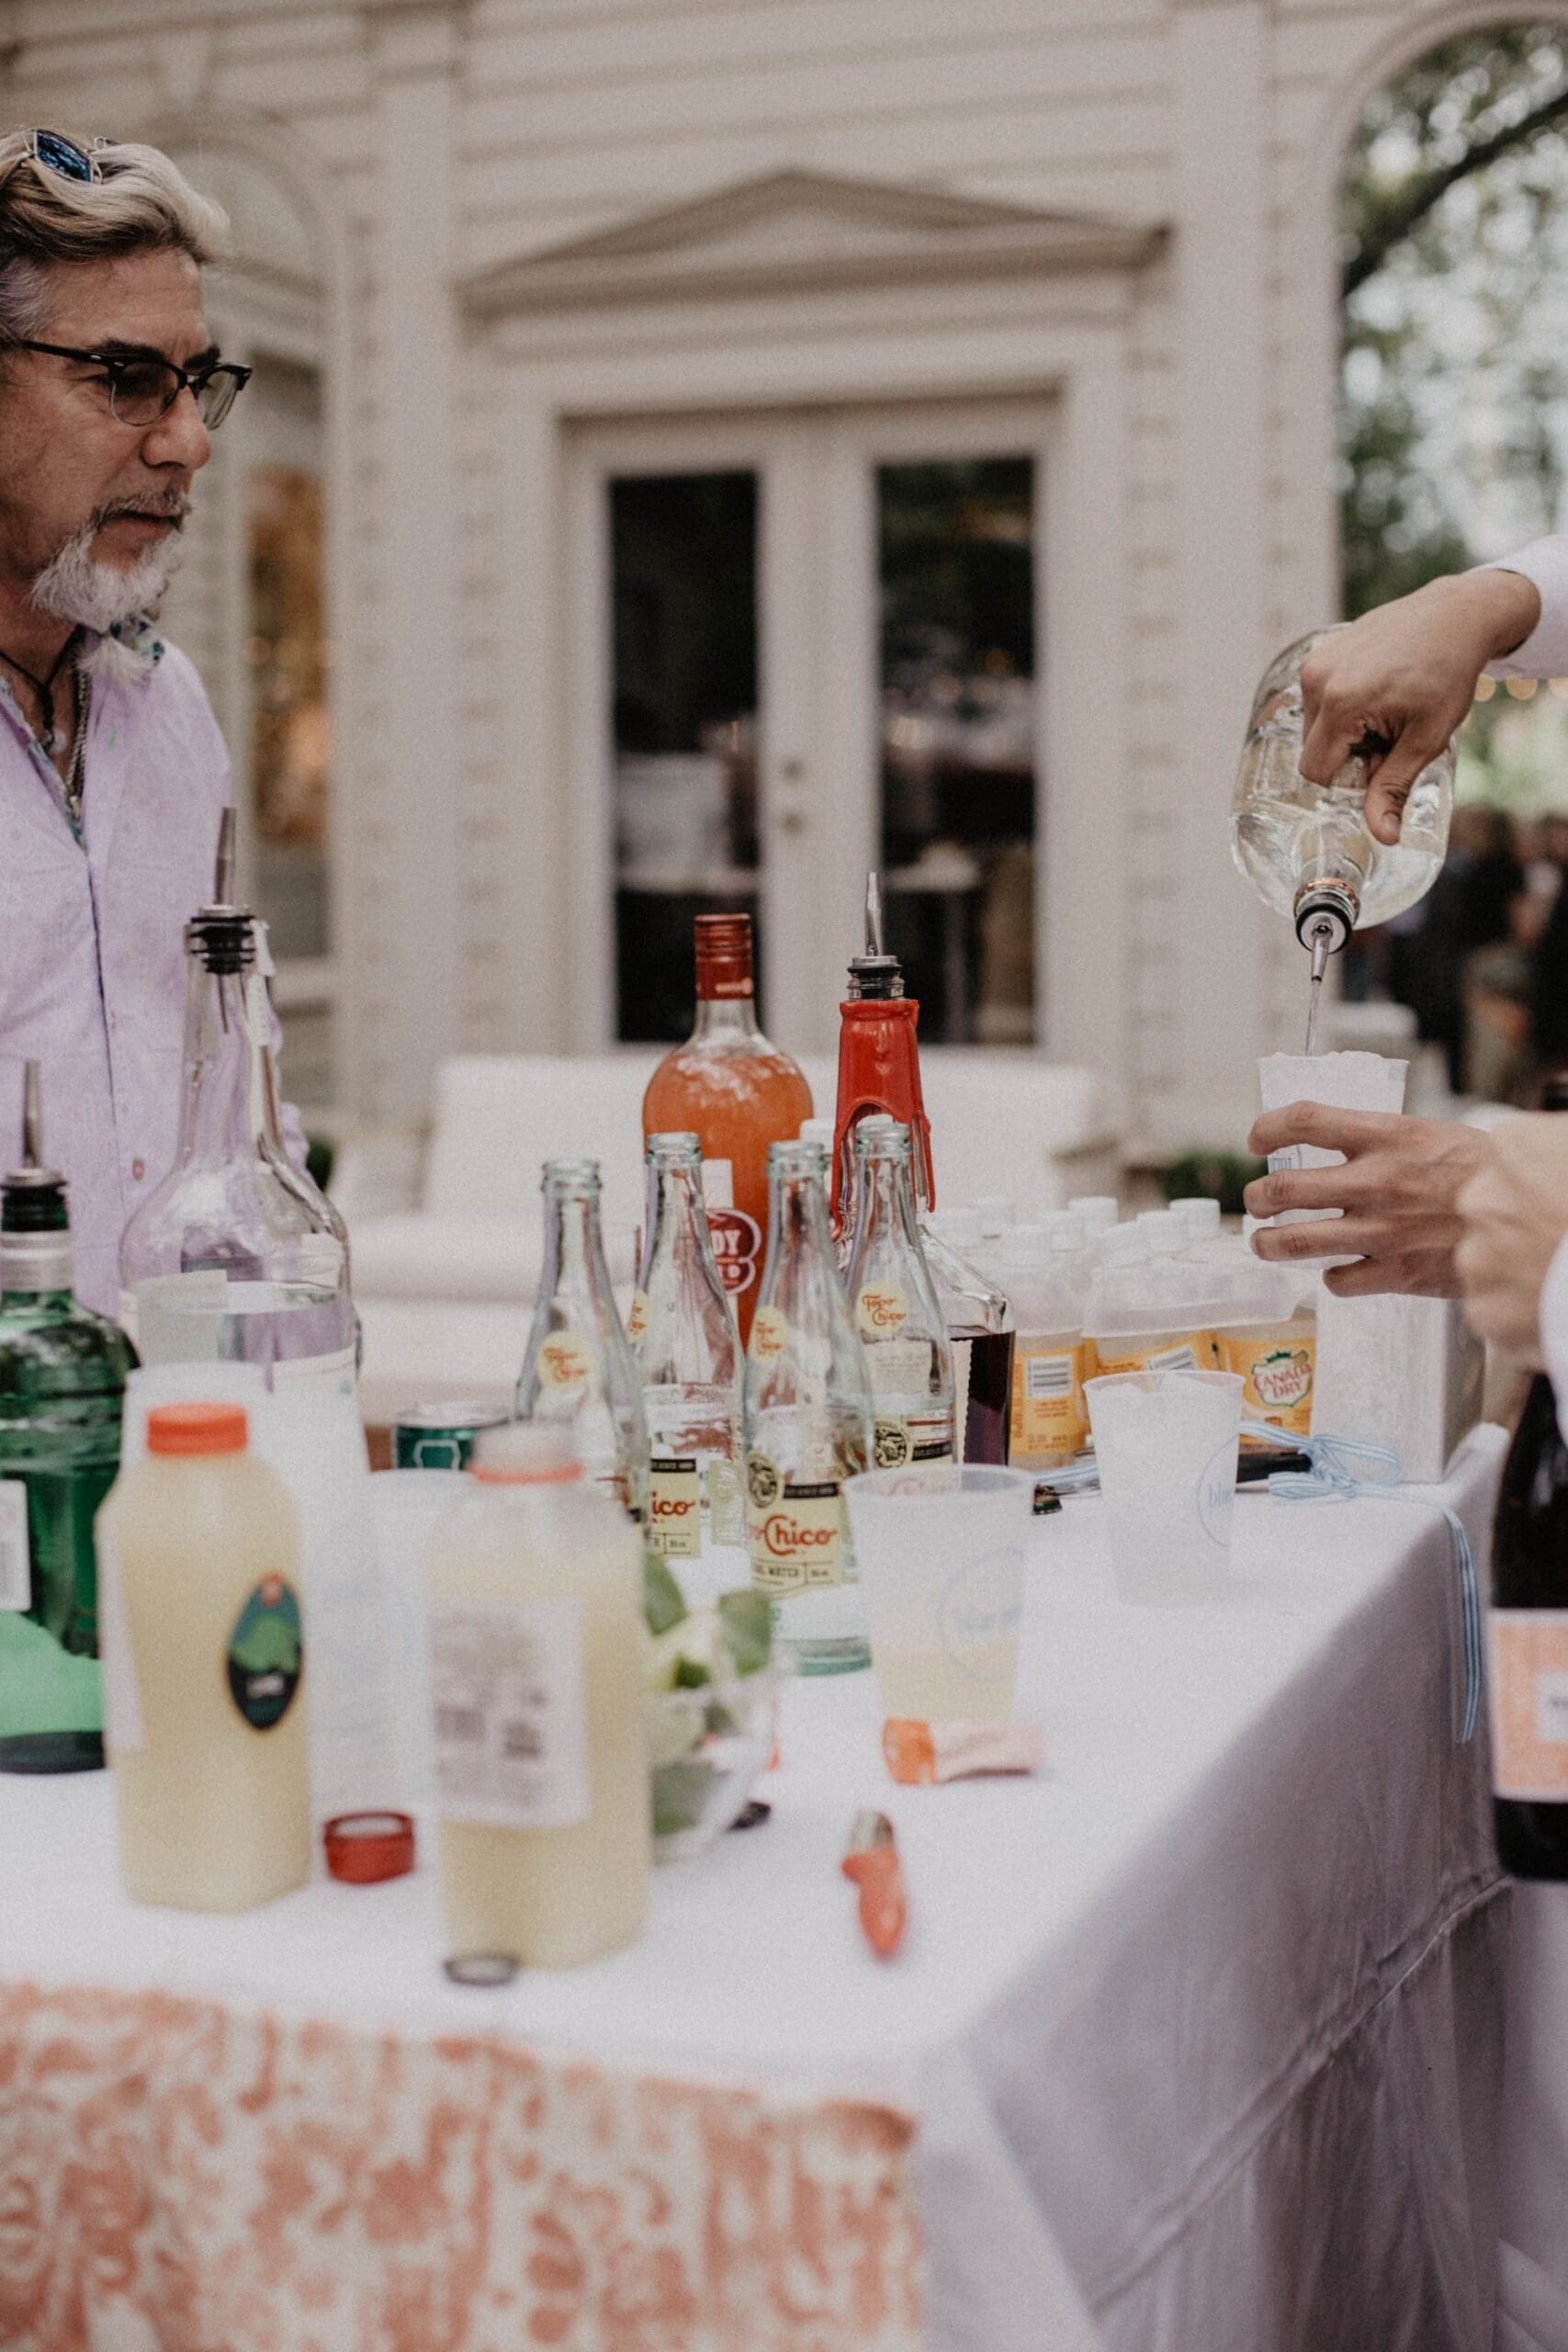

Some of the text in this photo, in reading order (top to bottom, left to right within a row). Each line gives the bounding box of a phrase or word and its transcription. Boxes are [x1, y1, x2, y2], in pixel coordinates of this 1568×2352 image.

[1253, 1363, 1312, 1393] CANADA
[651, 1490, 695, 1516] ico
[764, 1514, 837, 1556] Chico
